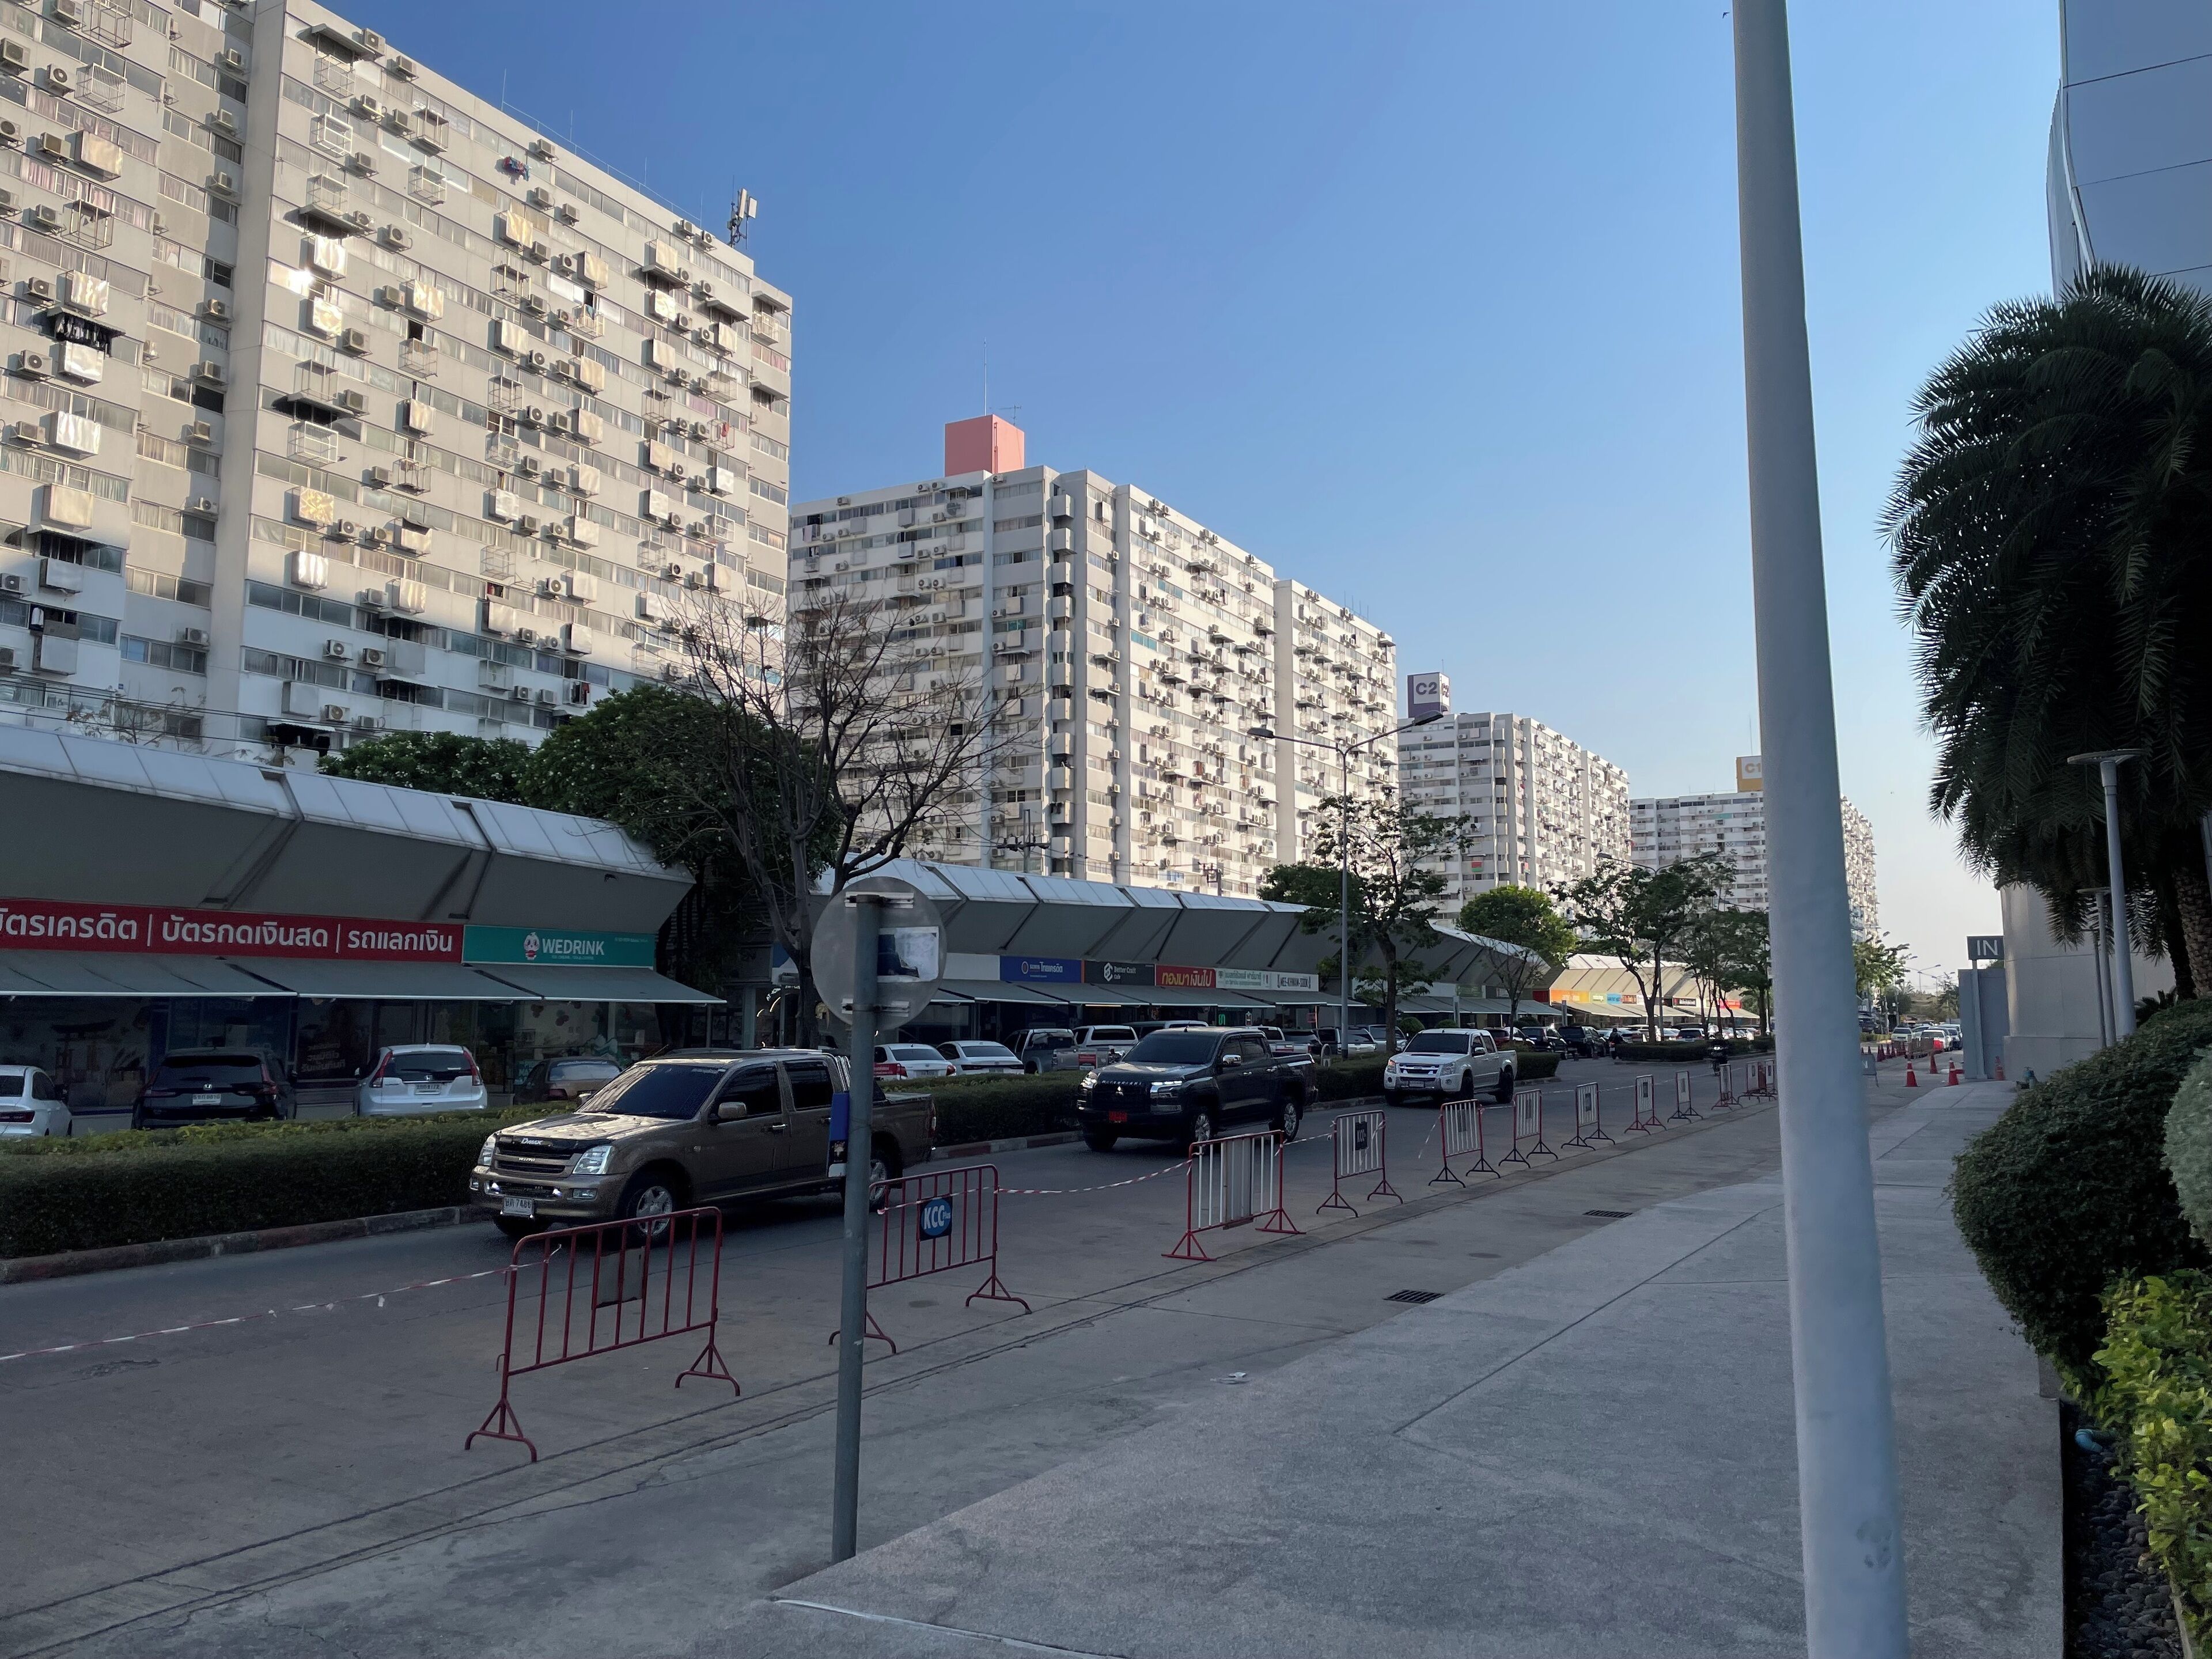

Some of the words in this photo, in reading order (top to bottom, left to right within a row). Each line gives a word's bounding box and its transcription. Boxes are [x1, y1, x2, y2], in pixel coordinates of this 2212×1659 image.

[1416, 682, 1437, 695] C2
[1745, 762, 1761, 773] C1
[0, 908, 137, 940] ัตรเครดิต
[162, 914, 328, 948] บัตรกดเงินสด
[347, 929, 452, 952] รถแลกเงิน
[542, 937, 605, 956] WEDRINK
[1977, 940, 1998, 956] IN
[1218, 1013, 1226, 1026] ยา
[923, 1205, 945, 1230] KCC
